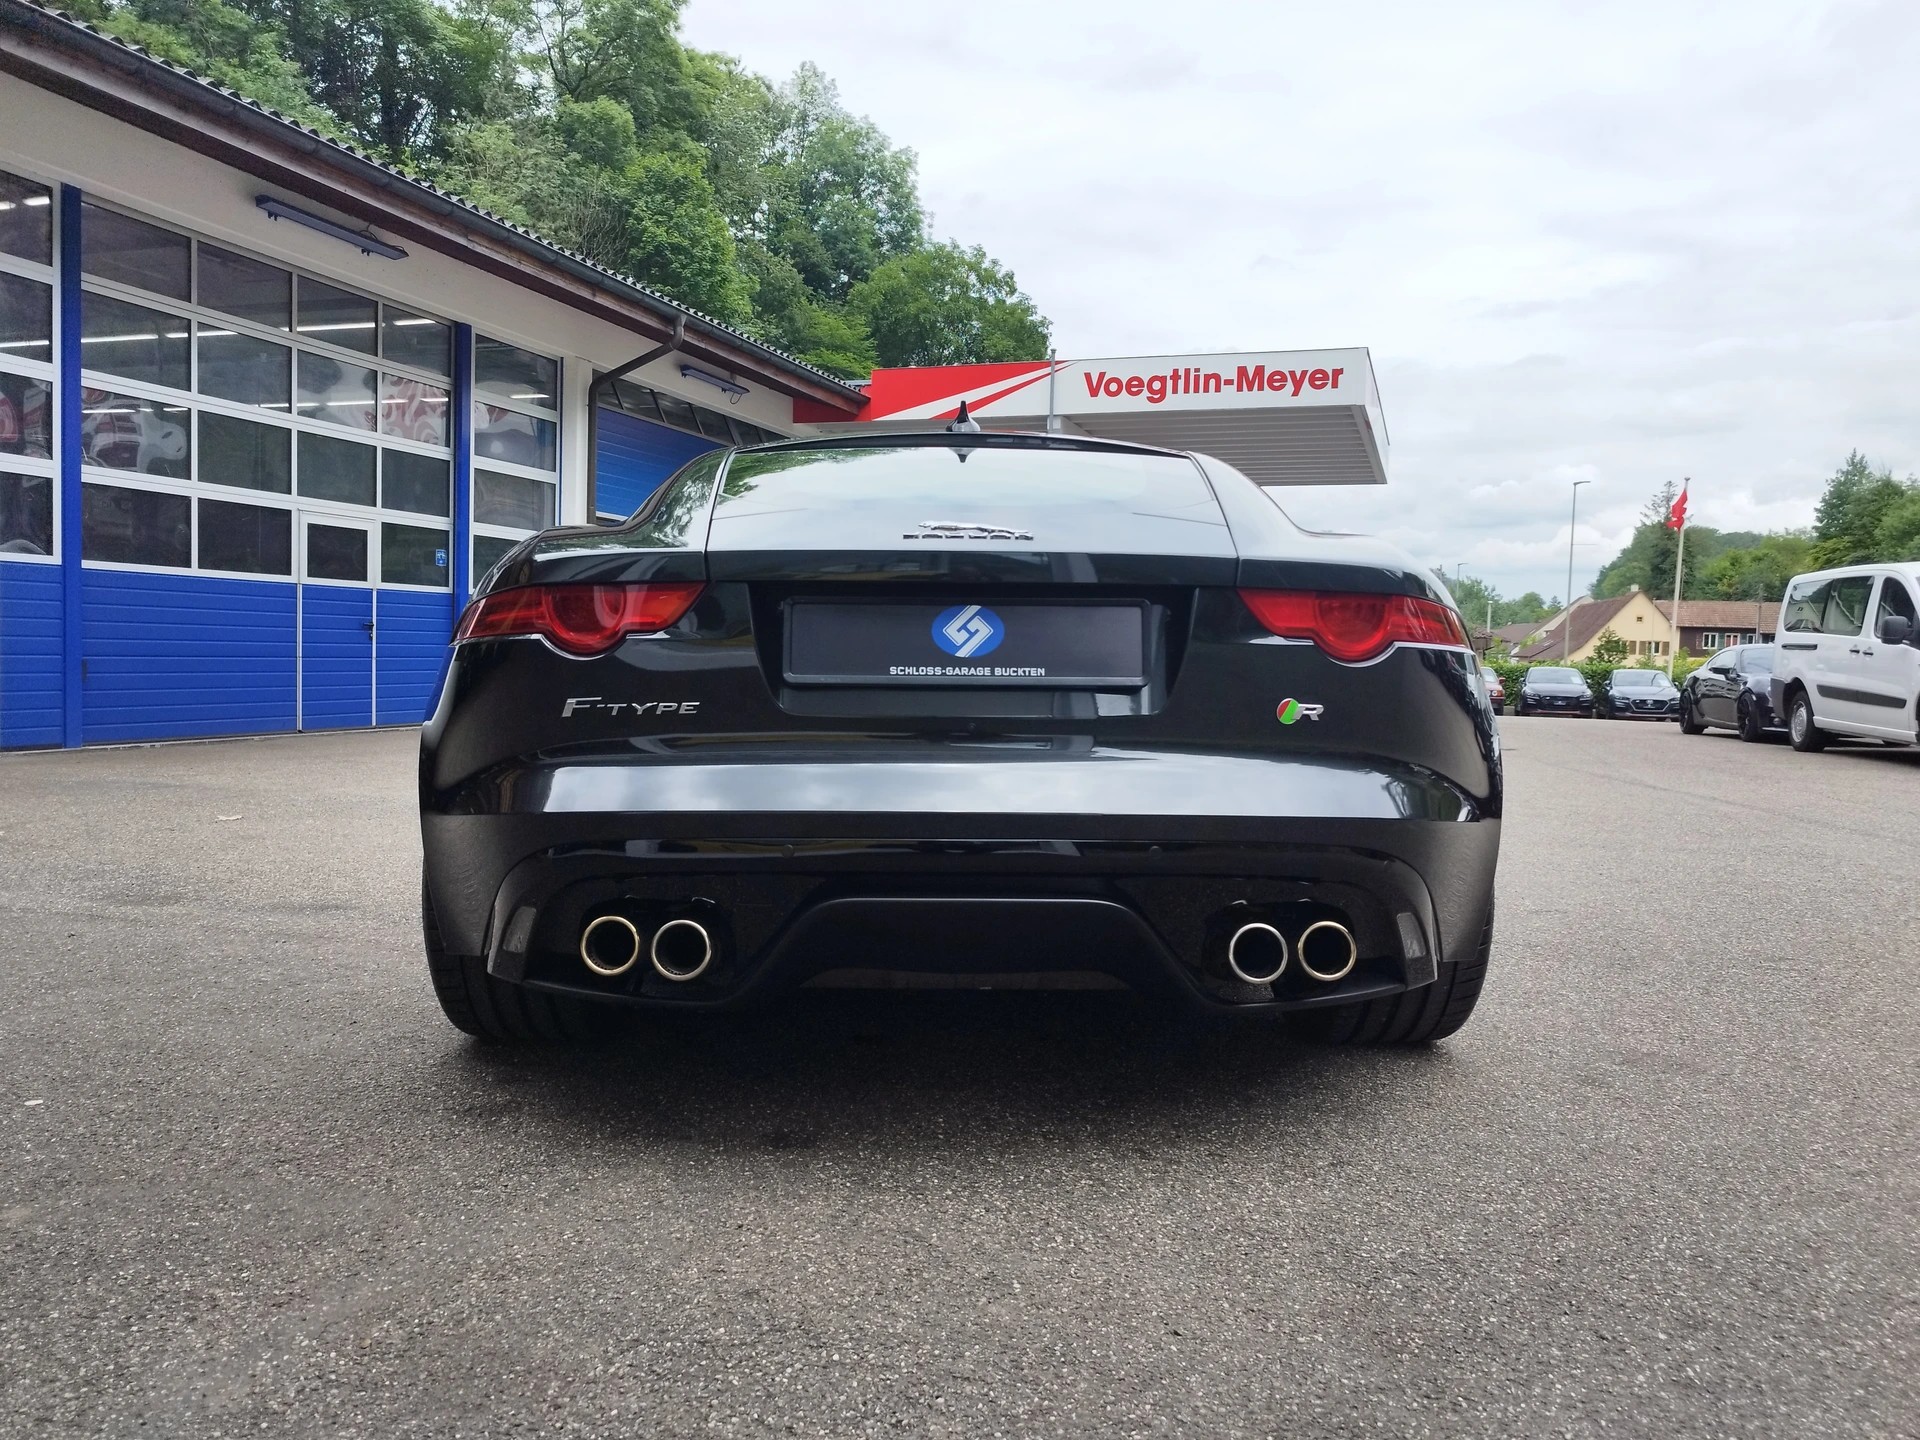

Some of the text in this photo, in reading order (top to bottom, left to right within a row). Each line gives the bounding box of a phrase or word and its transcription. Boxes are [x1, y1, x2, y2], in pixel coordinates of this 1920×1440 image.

[1083, 364, 1345, 404] Voegtlin-Meyer
[889, 666, 1046, 677] SCHLOSS-GARAGE BUCKTEN
[561, 696, 701, 718] F-TYPE
[1292, 703, 1325, 721] R
